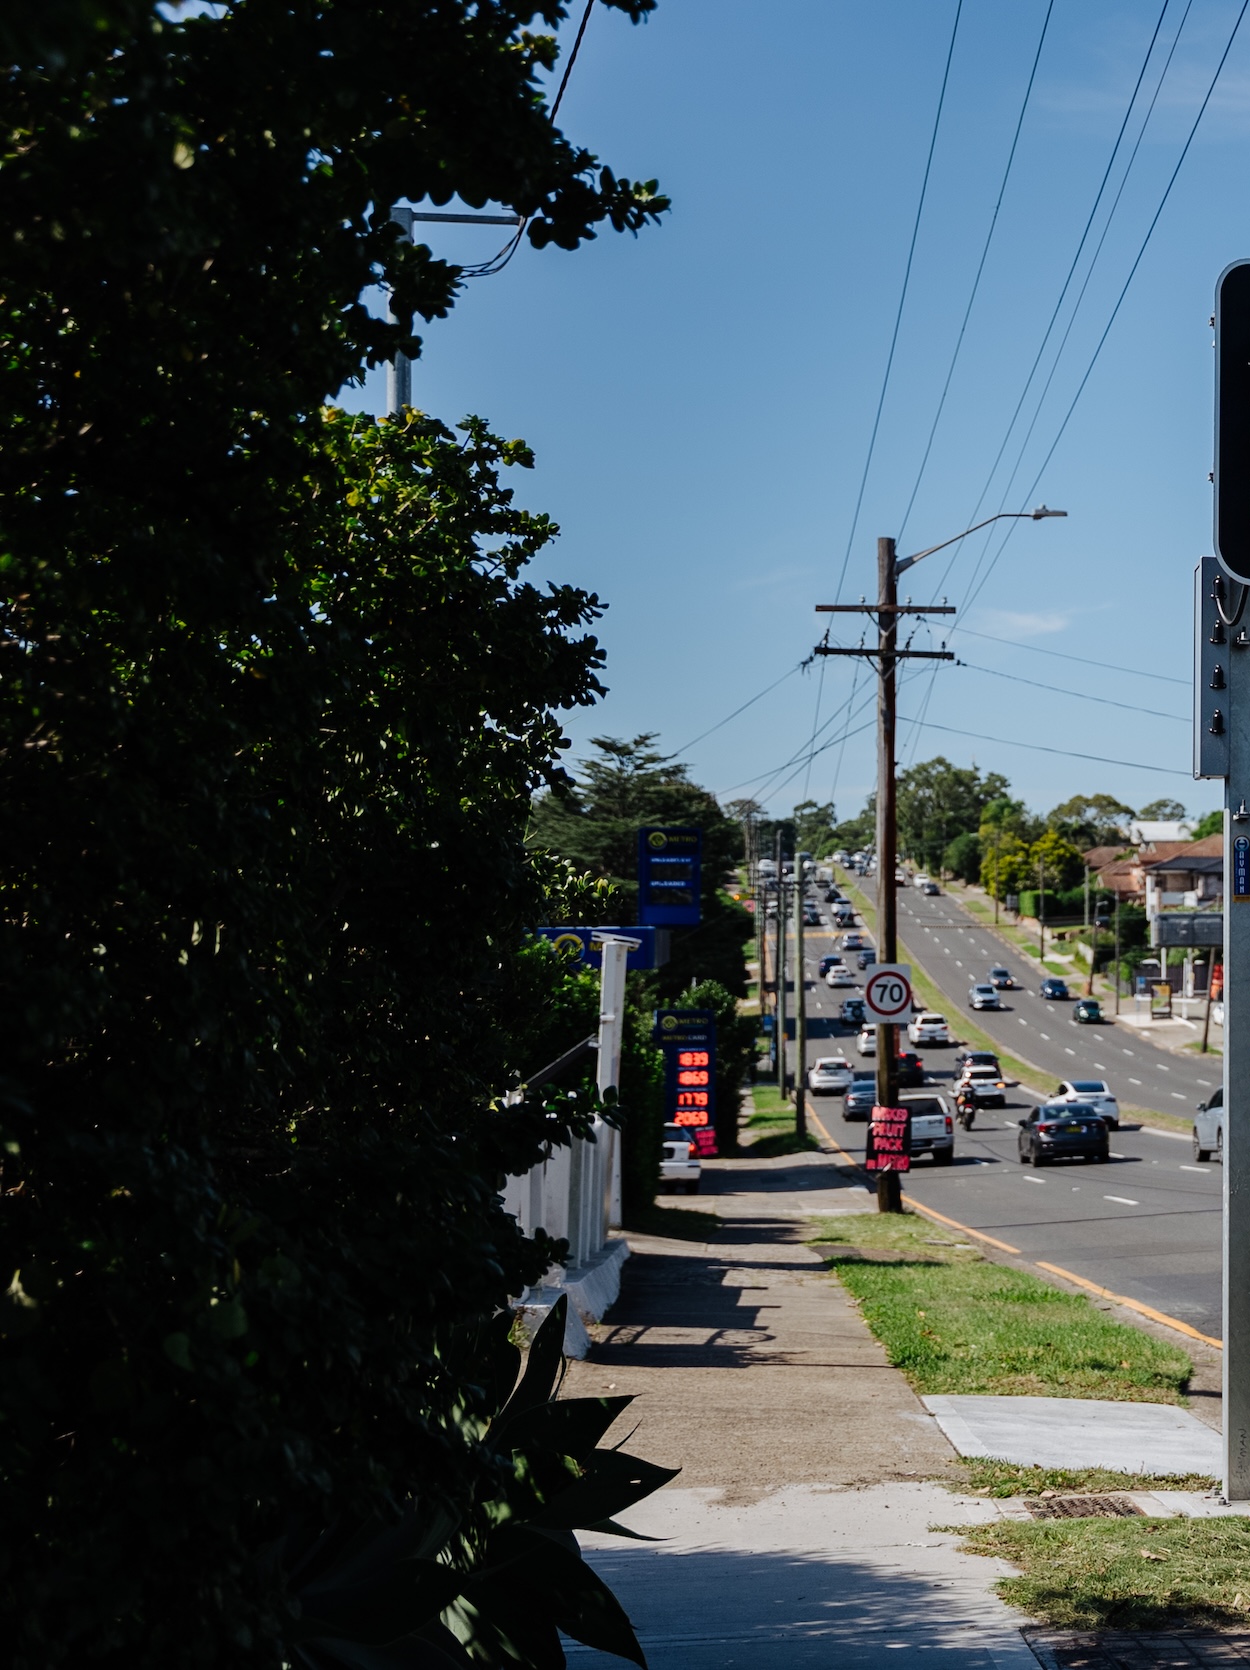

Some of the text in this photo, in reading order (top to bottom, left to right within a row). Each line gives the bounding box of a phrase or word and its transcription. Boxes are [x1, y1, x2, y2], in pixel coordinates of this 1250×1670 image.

[875, 983, 903, 1003] 70
[872, 1122, 907, 1137] FRUIT
[873, 1137, 903, 1151] PACK
